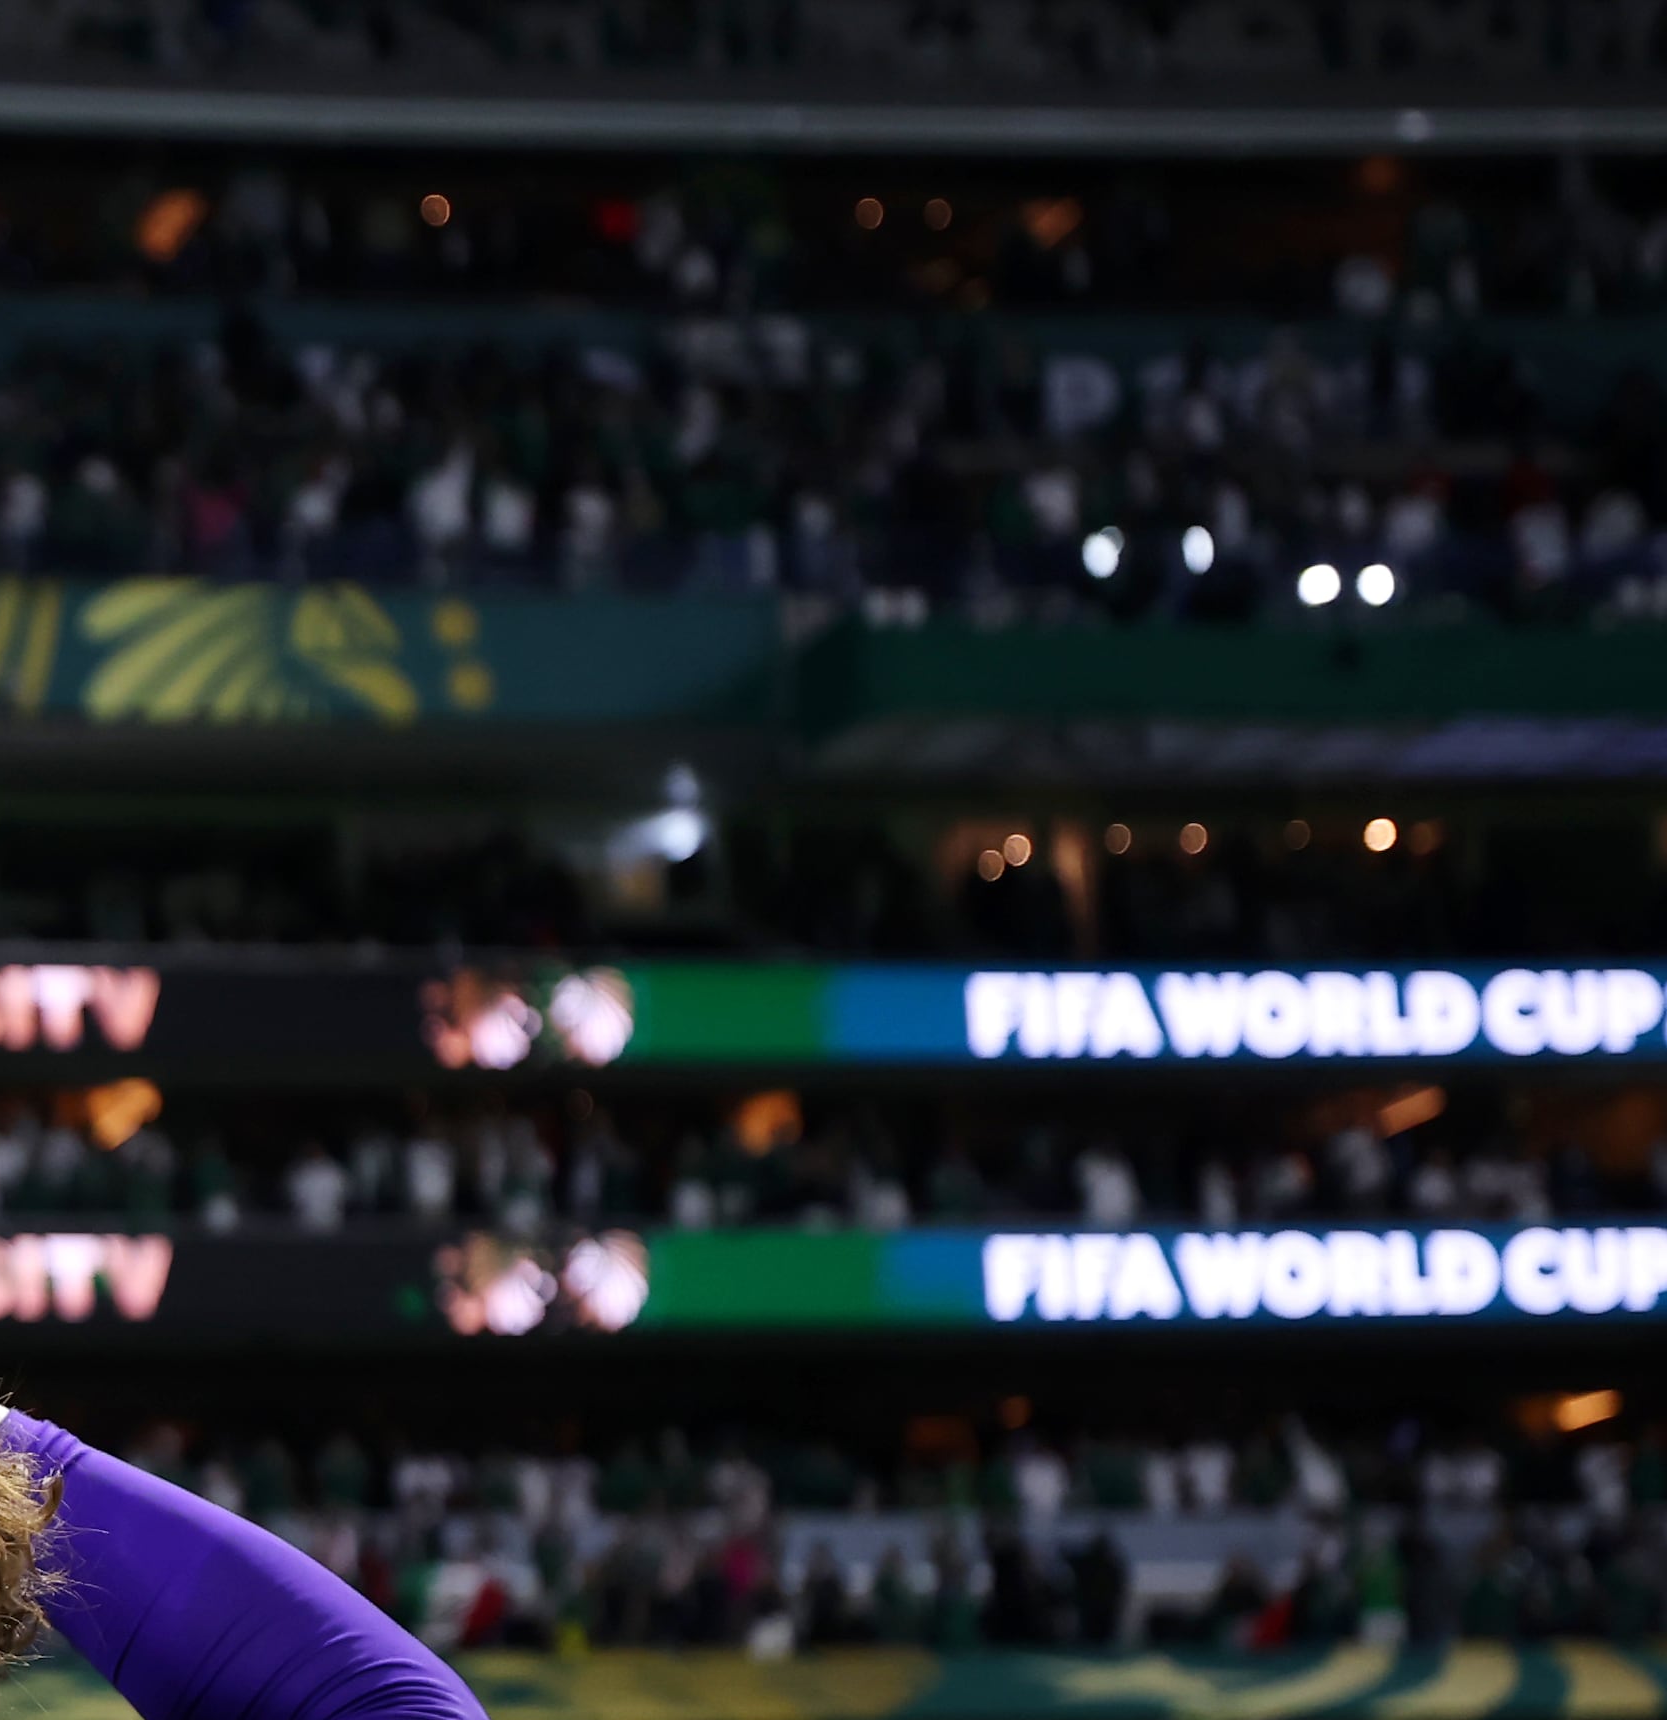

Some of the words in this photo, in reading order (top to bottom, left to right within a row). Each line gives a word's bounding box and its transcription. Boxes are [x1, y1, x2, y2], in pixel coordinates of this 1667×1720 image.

[965, 970, 1163, 1059] FIFA
[1157, 969, 1480, 1059] WORLD
[1482, 968, 1664, 1057] CUP
[982, 1232, 1181, 1321] FIFA
[1174, 1229, 1501, 1319] WORLD
[1502, 1226, 1667, 1316] CUP
